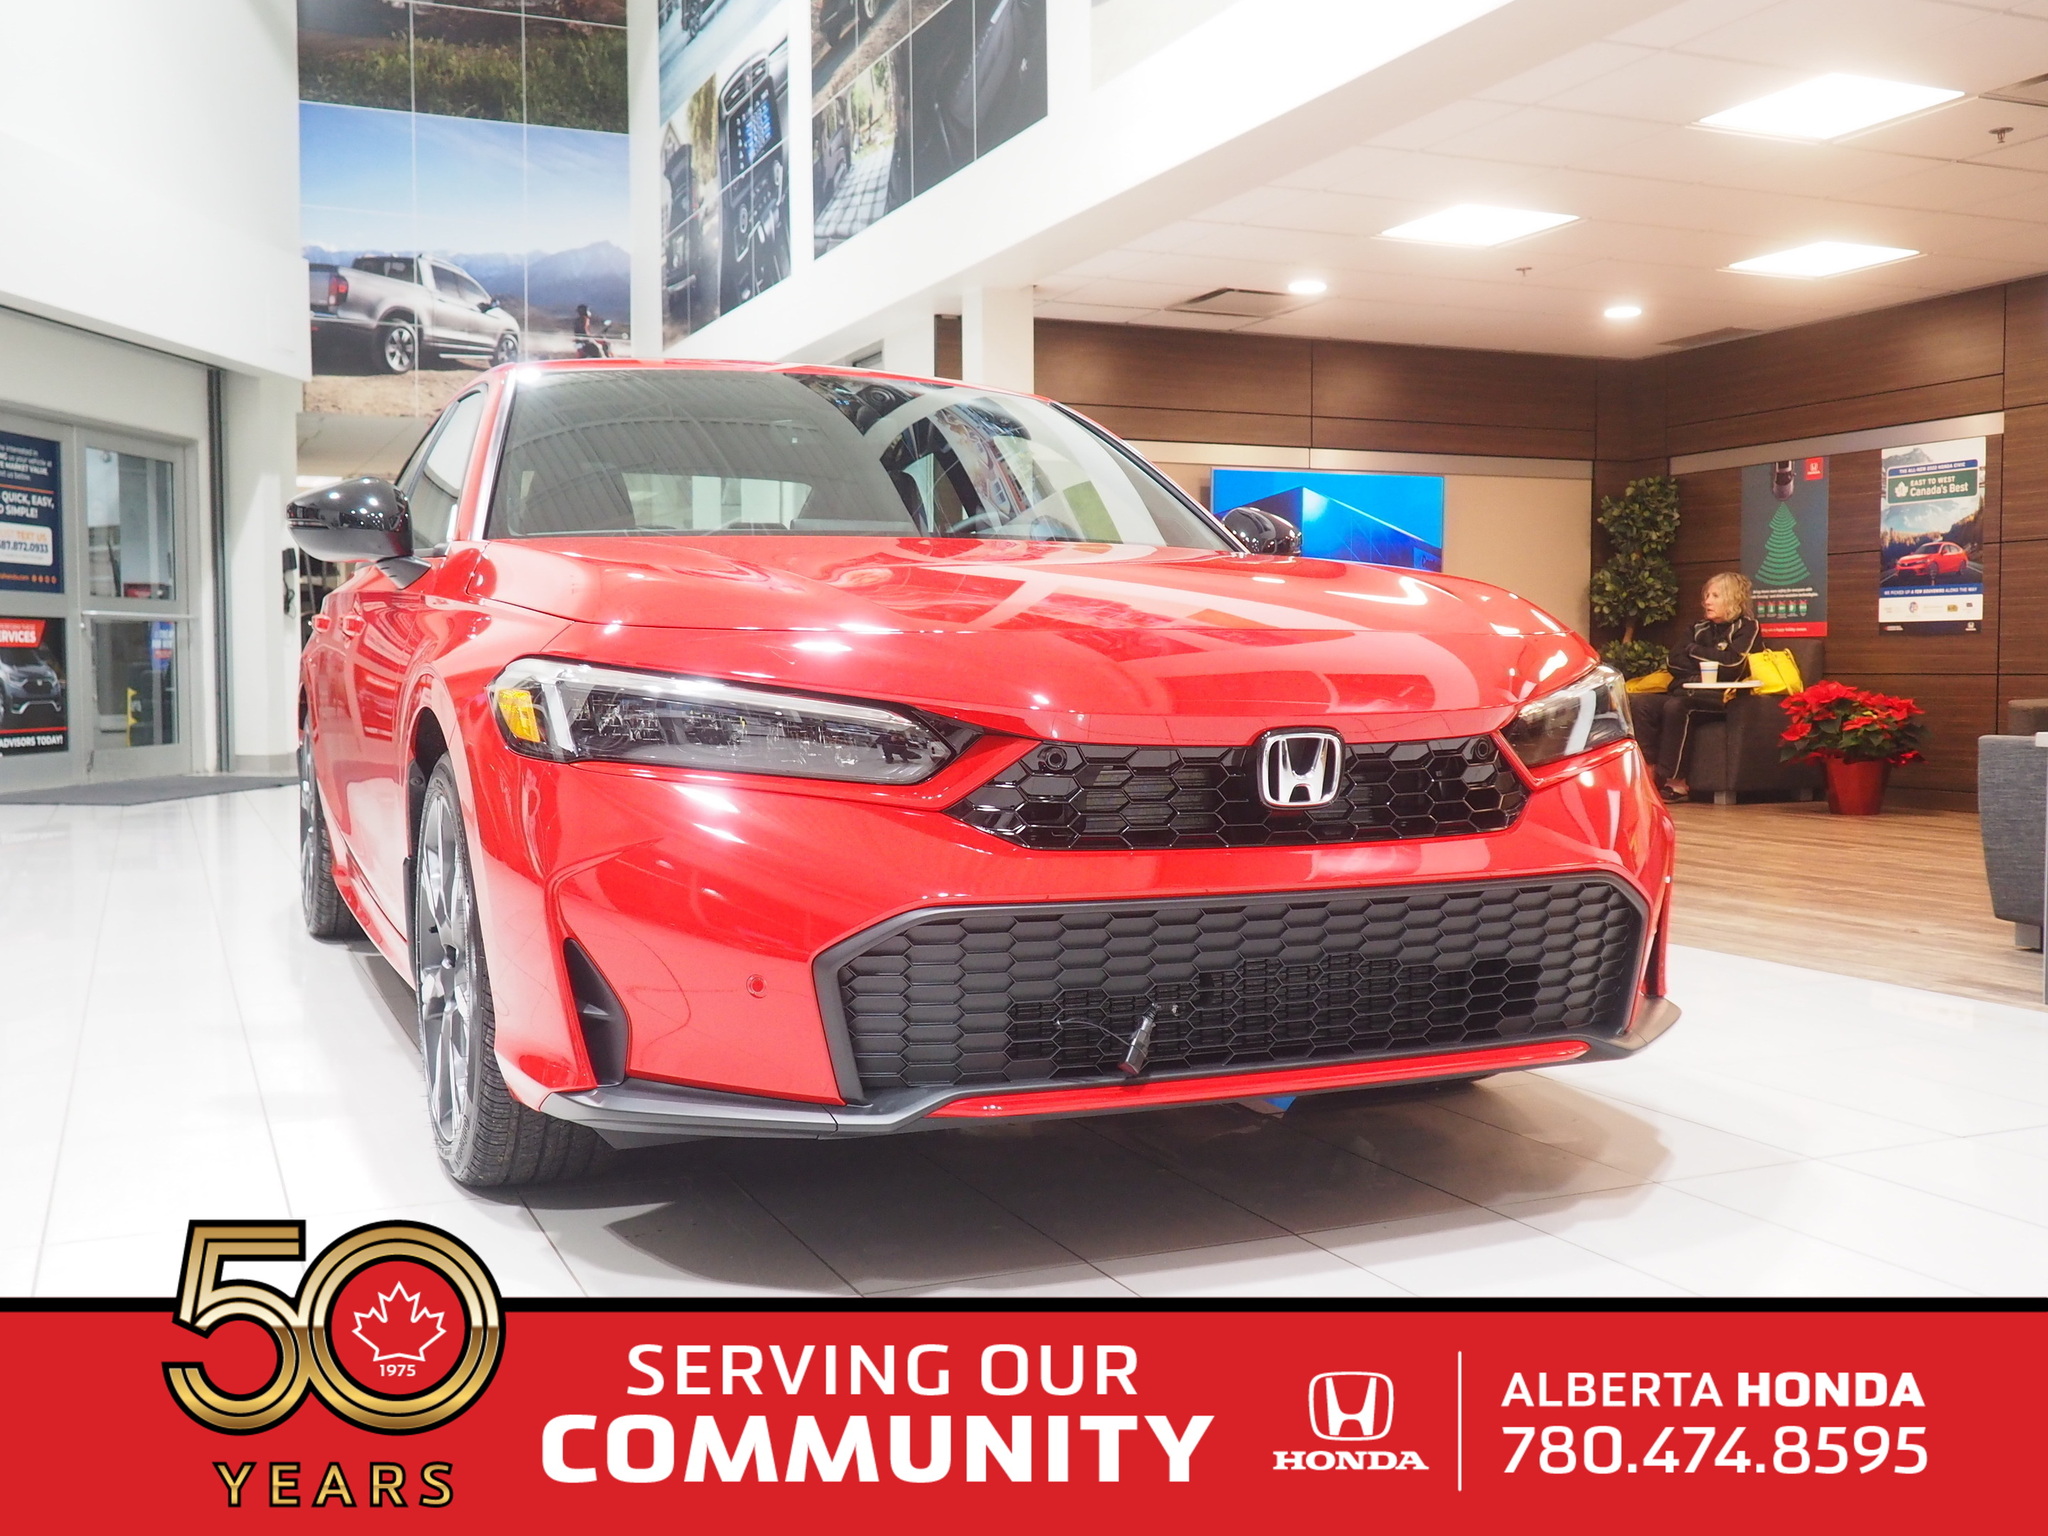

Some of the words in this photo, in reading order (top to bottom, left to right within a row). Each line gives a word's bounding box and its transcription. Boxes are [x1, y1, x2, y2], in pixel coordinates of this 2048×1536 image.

[1928, 477, 1937, 485] TO
[1937, 475, 1956, 484] WEST
[1910, 484, 1948, 497] Canada's
[1949, 482, 1969, 493] Best
[1, 490, 31, 506] QUICK,
[31, 495, 55, 510] EASY,
[5, 504, 38, 519] SIMPLE!
[36, 734, 64, 746] TODAY!
